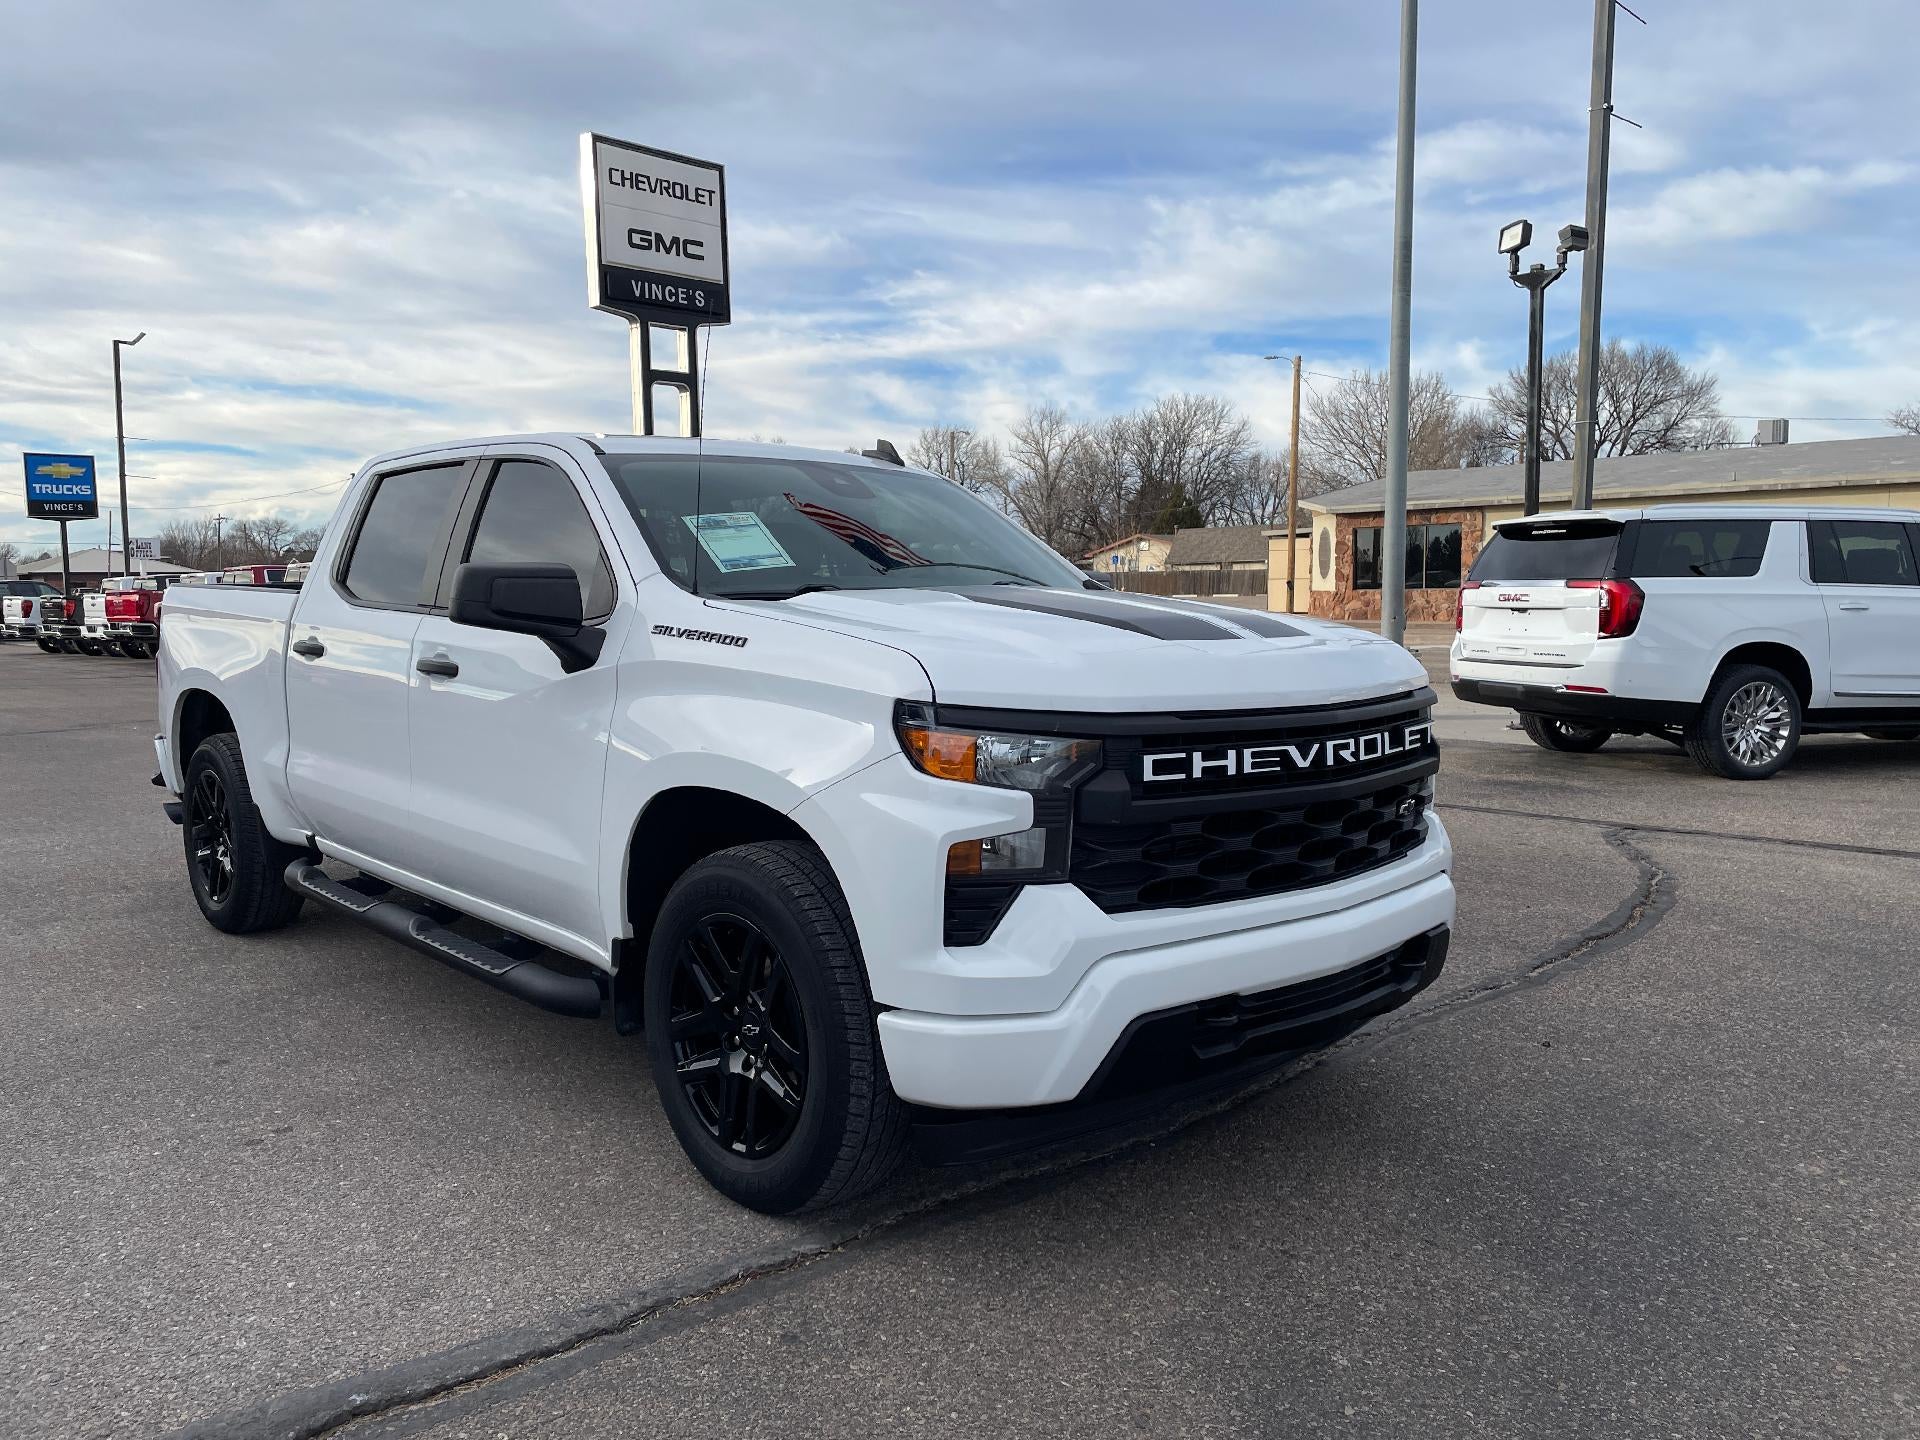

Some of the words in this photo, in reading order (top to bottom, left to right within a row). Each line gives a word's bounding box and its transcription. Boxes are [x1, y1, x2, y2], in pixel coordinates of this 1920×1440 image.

[608, 167, 716, 207] CHEVROLET
[627, 227, 705, 261] GMC
[631, 279, 705, 307] VINCE'S
[32, 483, 92, 495] TRUCKS
[43, 502, 84, 511] VINCE'S
[1498, 593, 1530, 602] GMC
[651, 624, 749, 648] SILVERADO
[1142, 720, 1434, 783] CHEVROLET
